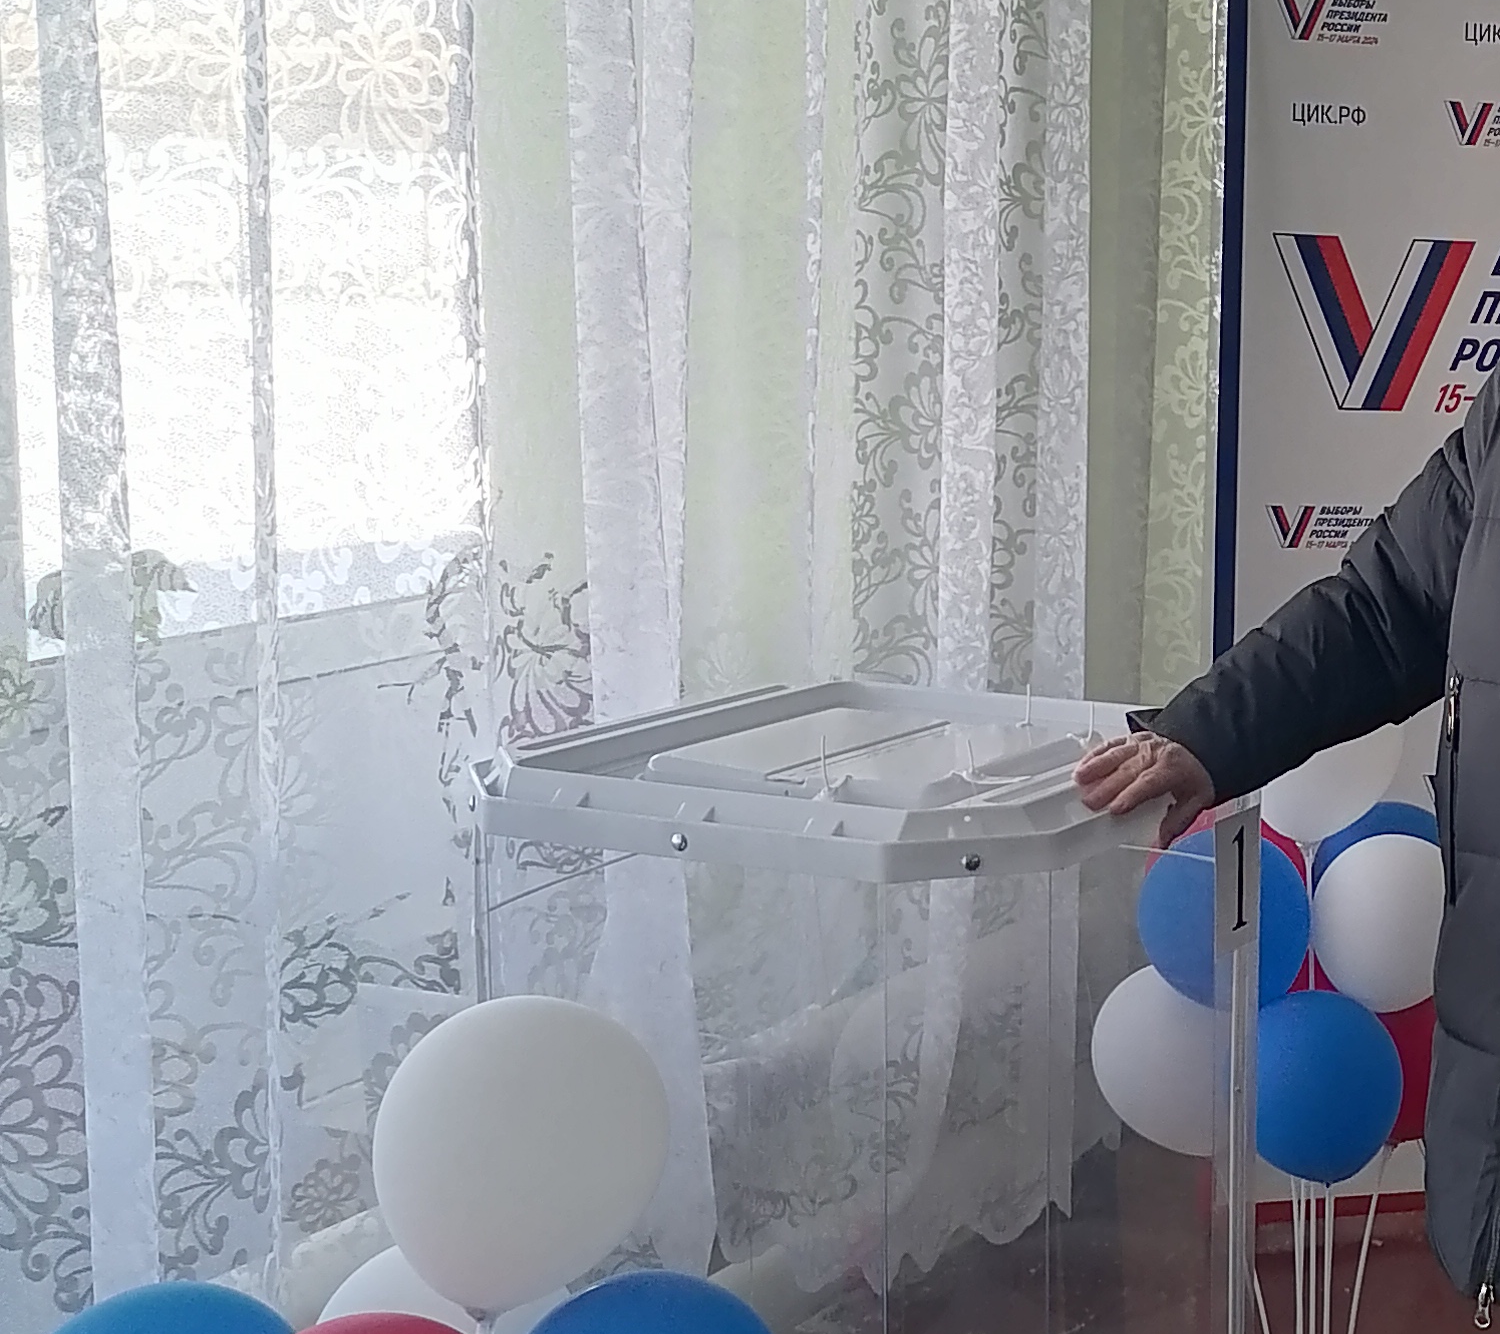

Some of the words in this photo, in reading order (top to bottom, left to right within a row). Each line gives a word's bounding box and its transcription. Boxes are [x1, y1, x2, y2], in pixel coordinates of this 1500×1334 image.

[1326, 9, 1388, 23] ПРЕЗИДЕНТА
[1320, 22, 1361, 33] РОССИИ
[1292, 102, 1367, 127] ЦИК.РФ
[1319, 506, 1363, 516] ВЫБОРЫ
[1309, 529, 1349, 539] РОССИИ
[1231, 824, 1248, 932] 1
